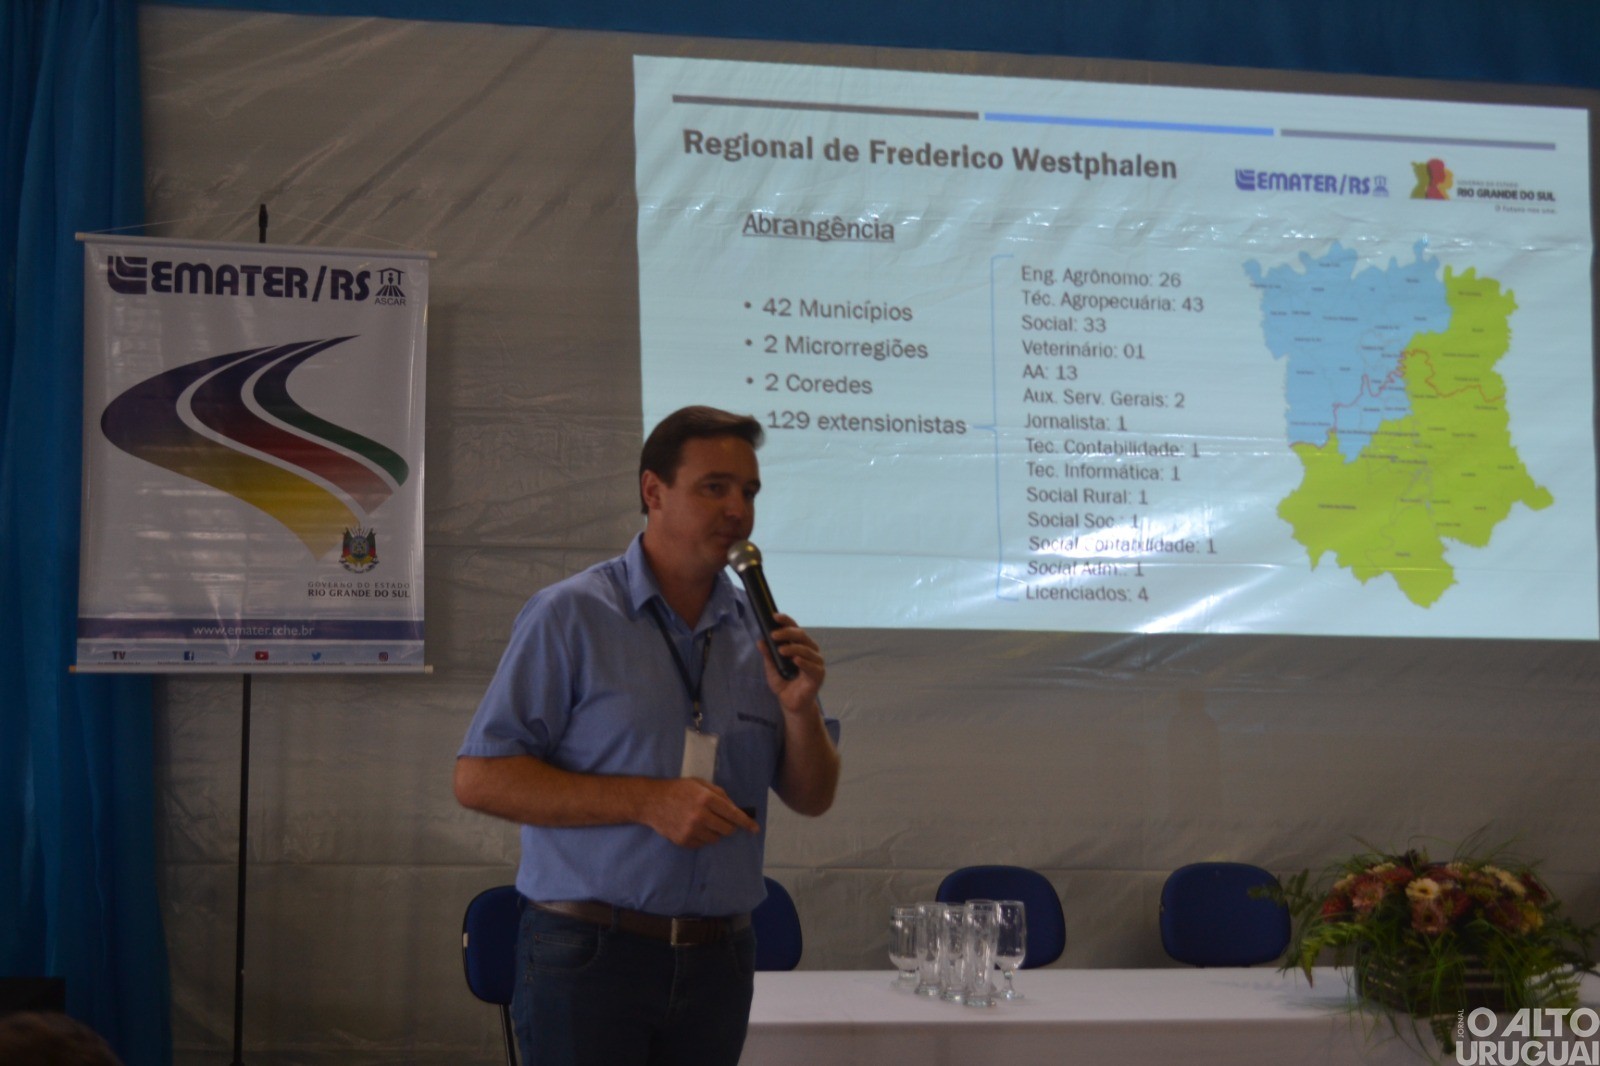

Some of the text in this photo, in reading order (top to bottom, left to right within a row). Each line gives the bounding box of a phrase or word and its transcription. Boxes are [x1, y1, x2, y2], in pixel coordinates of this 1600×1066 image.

[681, 128, 1178, 180] Regional de Frederico Westphalen
[1256, 171, 1371, 196] EMATER/RS
[1457, 188, 1556, 201] RIO GRANDE DO SUL
[742, 213, 896, 243] Abrangência
[151, 261, 371, 302] EMATER/RS
[1021, 265, 1182, 288] Eng. Agrônomo: 26
[374, 297, 406, 307] ASCAR
[1022, 289, 1204, 312] Téc. Agropecuária: 43
[762, 298, 913, 323] 42 Municípios
[1021, 315, 1107, 333] Social: 33
[764, 335, 929, 361] 2 Microrregiões
[1022, 340, 1145, 359] Veterinário: 01
[1022, 364, 1078, 381] AA: 13
[765, 373, 873, 394] 2 Coredes
[1023, 388, 1185, 408] Aux. Serv. Gerais: 2
[767, 410, 967, 434] 129 extensionistas
[1024, 413, 1128, 431] Jornalista: 1
[1026, 437, 1200, 458] Tec. Contabilidade: 1
[1026, 462, 1181, 481] Tec. Informática: 1
[1027, 486, 1149, 505] Social Rural: 1
[1028, 511, 1079, 527] Social
[1131, 514, 1139, 528] 1
[1029, 536, 1217, 554] Social ontabilidade: 1
[1027, 560, 1077, 576] Social
[1134, 561, 1144, 577] 1
[308, 589, 410, 599] RIO GRANDE DO SUL
[374, 582, 410, 590] ESTADO
[1026, 586, 1149, 601] Licenciados: 4
[192, 624, 315, 637] www.emater.tche.br
[112, 651, 126, 660] TV
